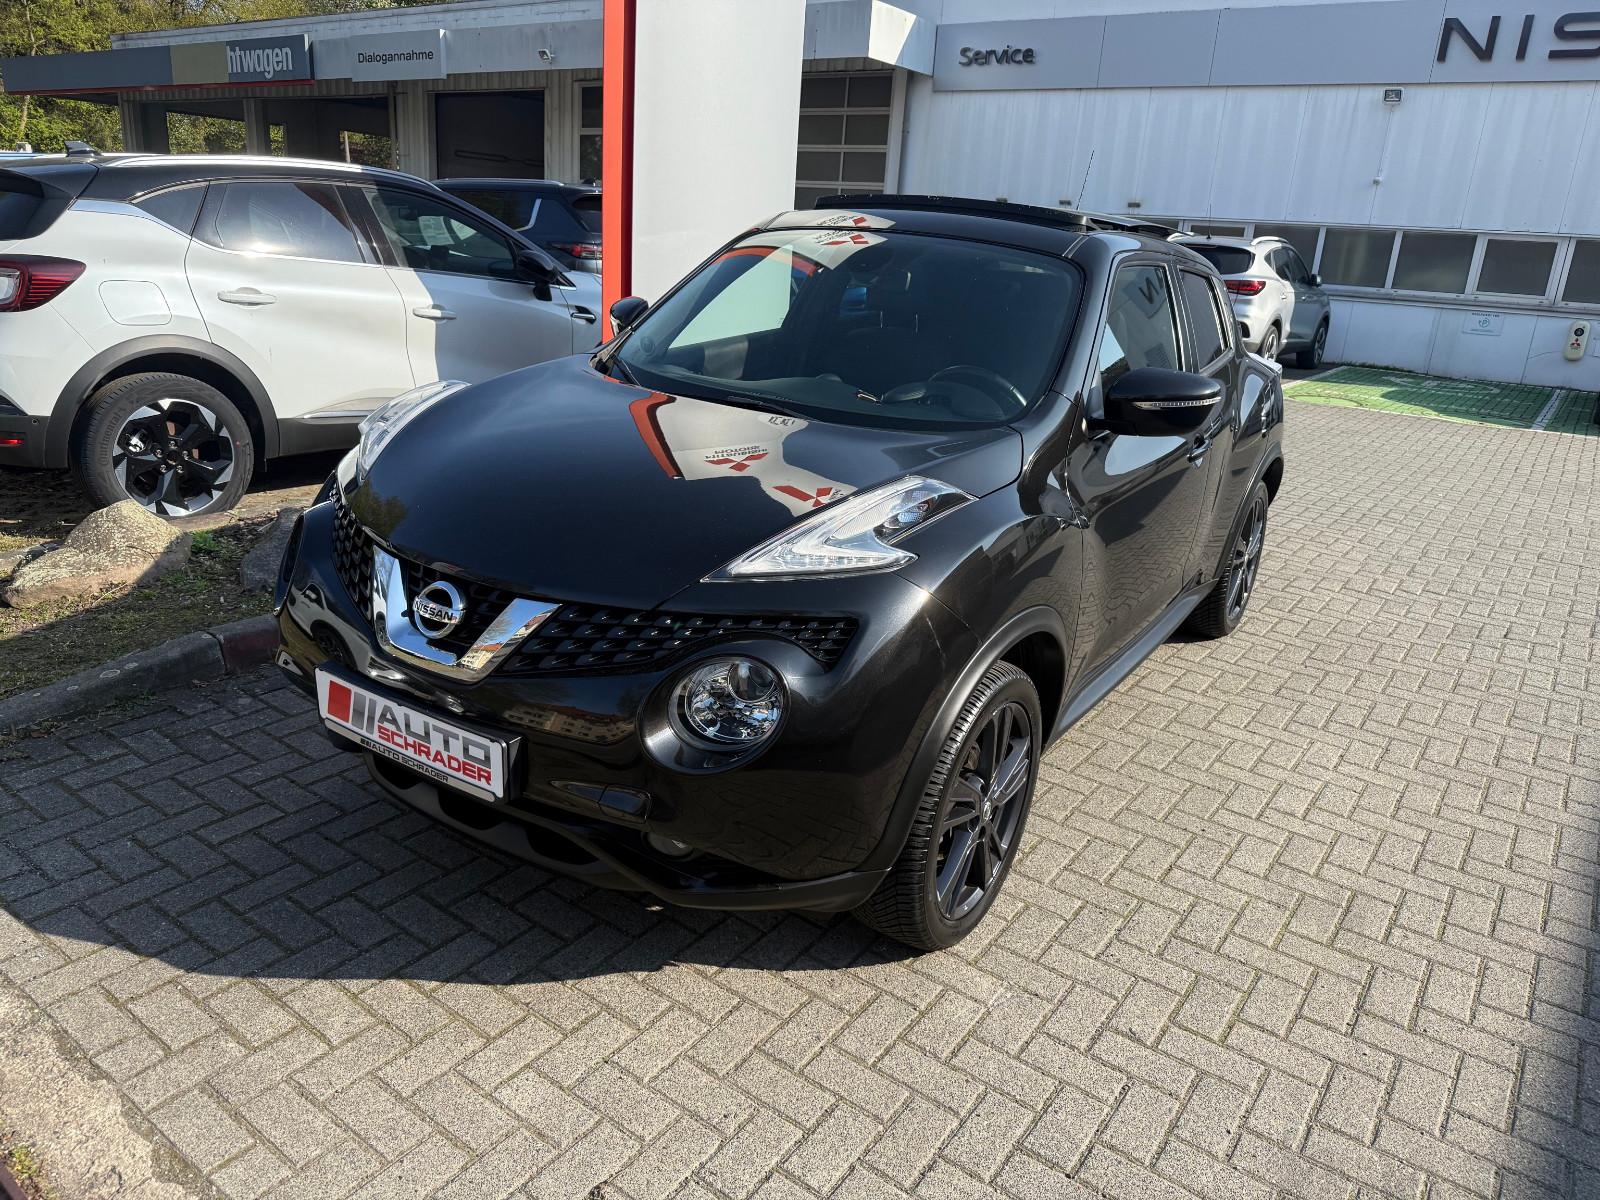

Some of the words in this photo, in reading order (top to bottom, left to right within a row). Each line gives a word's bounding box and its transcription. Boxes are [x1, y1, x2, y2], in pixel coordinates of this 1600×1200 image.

[959, 44, 1035, 66] Service
[1437, 12, 1600, 62] NIS
[226, 45, 293, 79] htwagen
[357, 49, 434, 65] Dialogannahme
[415, 600, 454, 621] NISSAN
[377, 704, 492, 769] AUTO
[372, 743, 400, 761] AUTO
[401, 756, 449, 782] SCHRADER
[377, 724, 492, 786] SCHRADER
